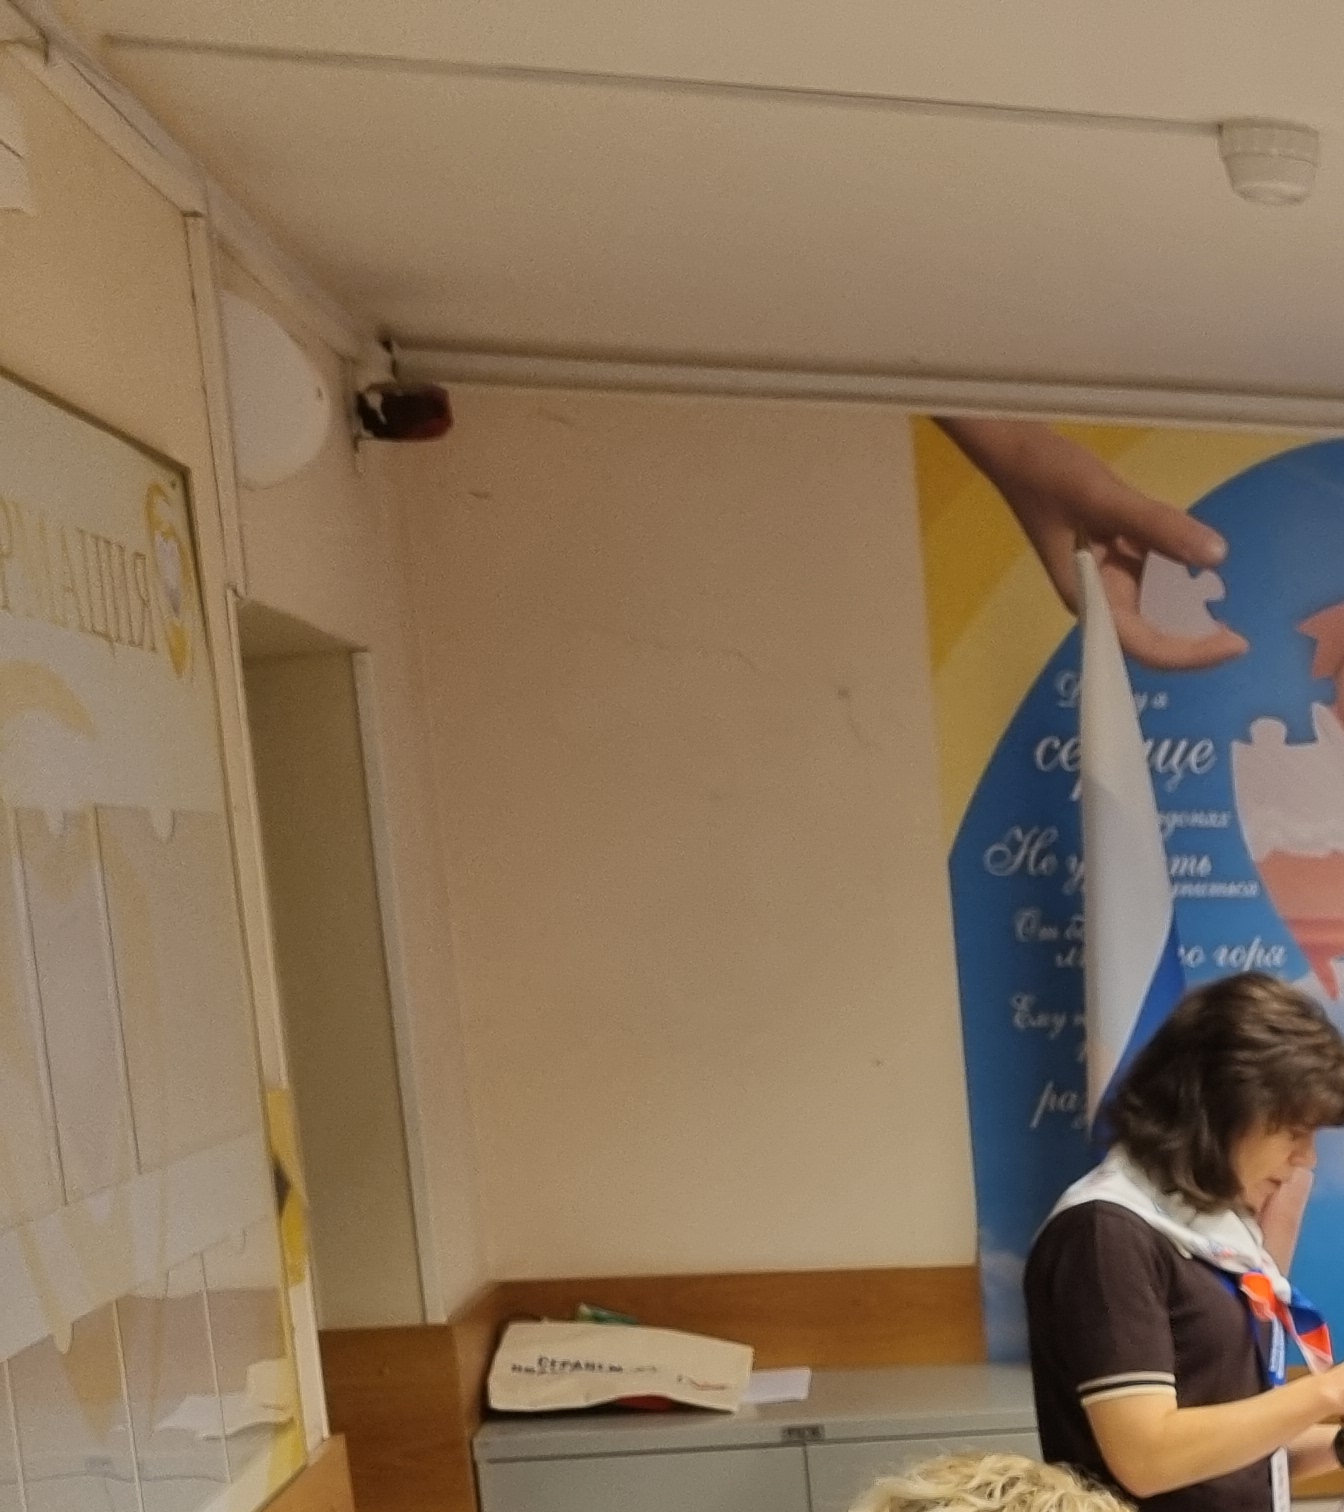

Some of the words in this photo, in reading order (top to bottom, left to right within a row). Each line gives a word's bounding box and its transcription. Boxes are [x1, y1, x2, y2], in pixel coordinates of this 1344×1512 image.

[0, 497, 157, 657] РМАЦИЯ
[1033, 735, 1218, 801] сеце
[1212, 935, 1287, 971] горя
